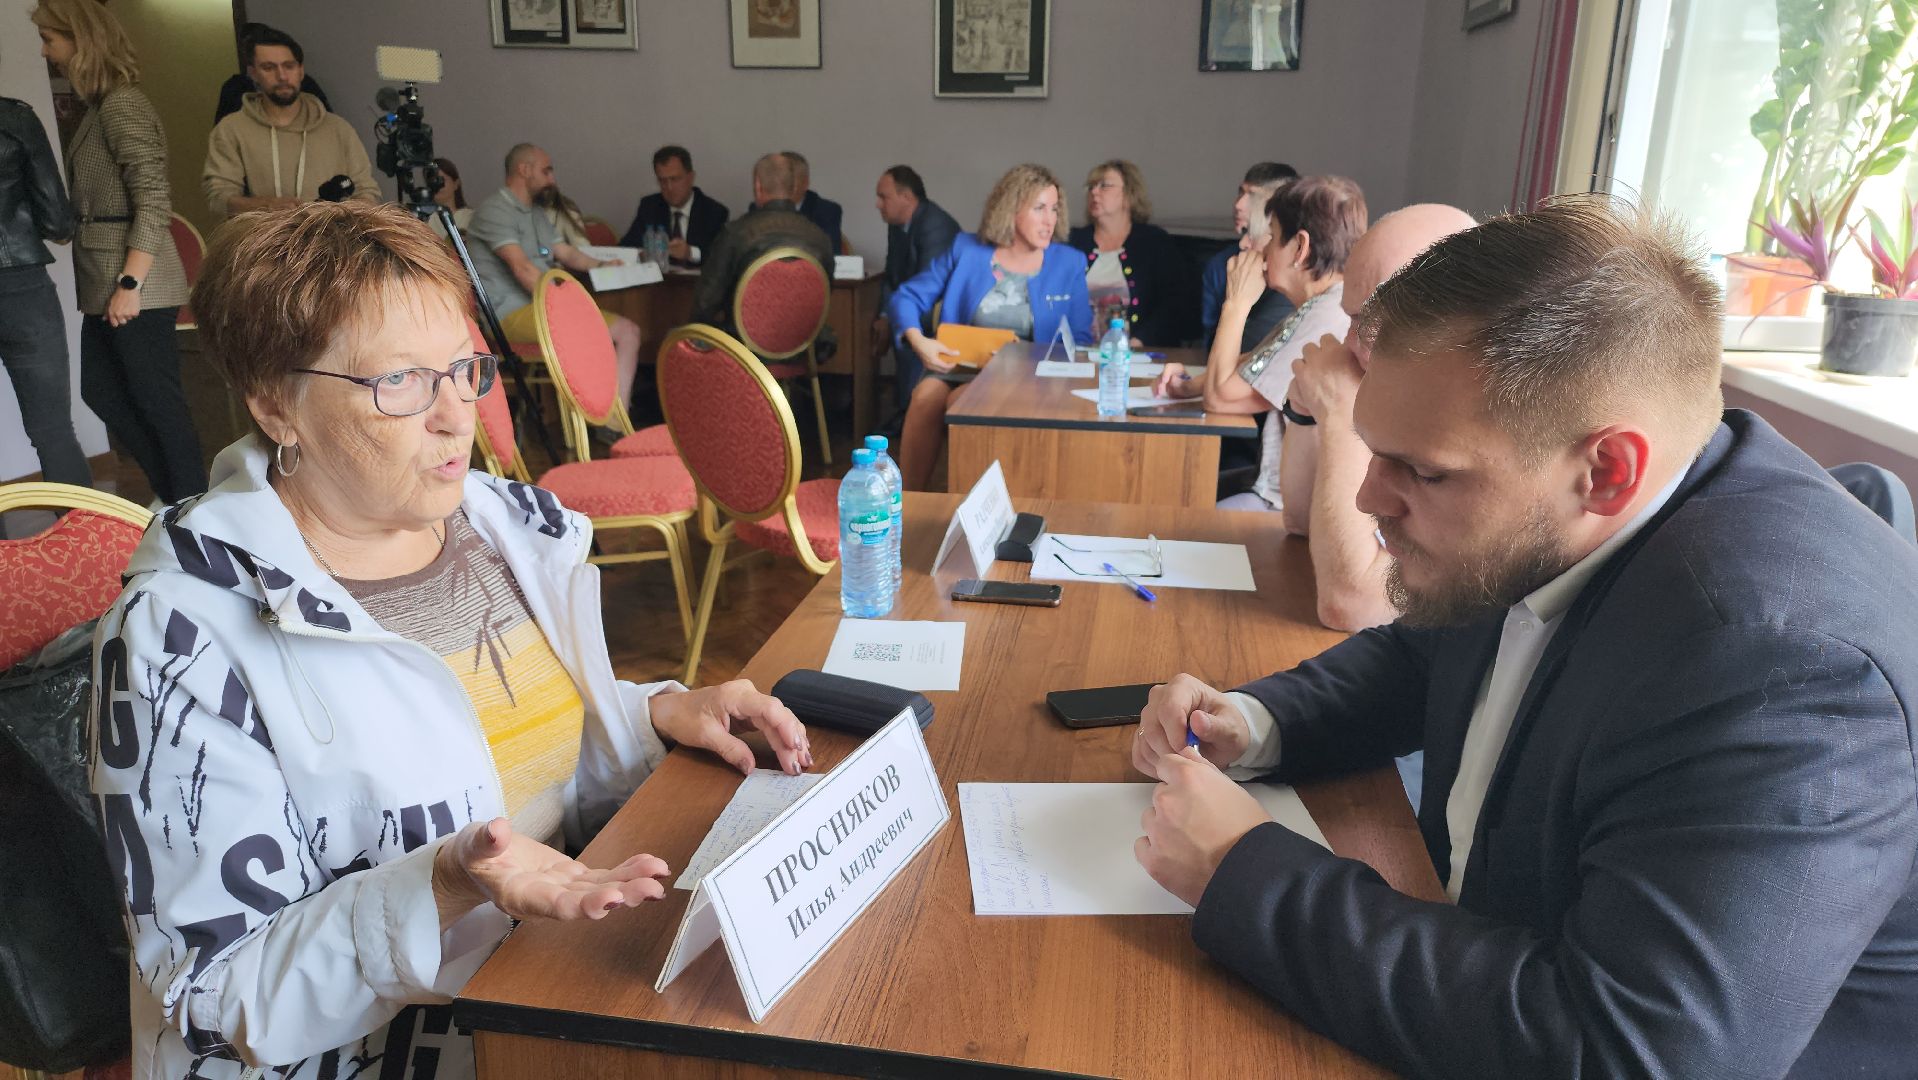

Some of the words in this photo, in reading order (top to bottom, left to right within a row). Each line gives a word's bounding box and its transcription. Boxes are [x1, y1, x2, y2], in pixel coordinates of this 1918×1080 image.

[763, 764, 901, 906] ПРОСНЯКОВ
[785, 884, 837, 940] Илья
[841, 807, 914, 893] Андреевич
